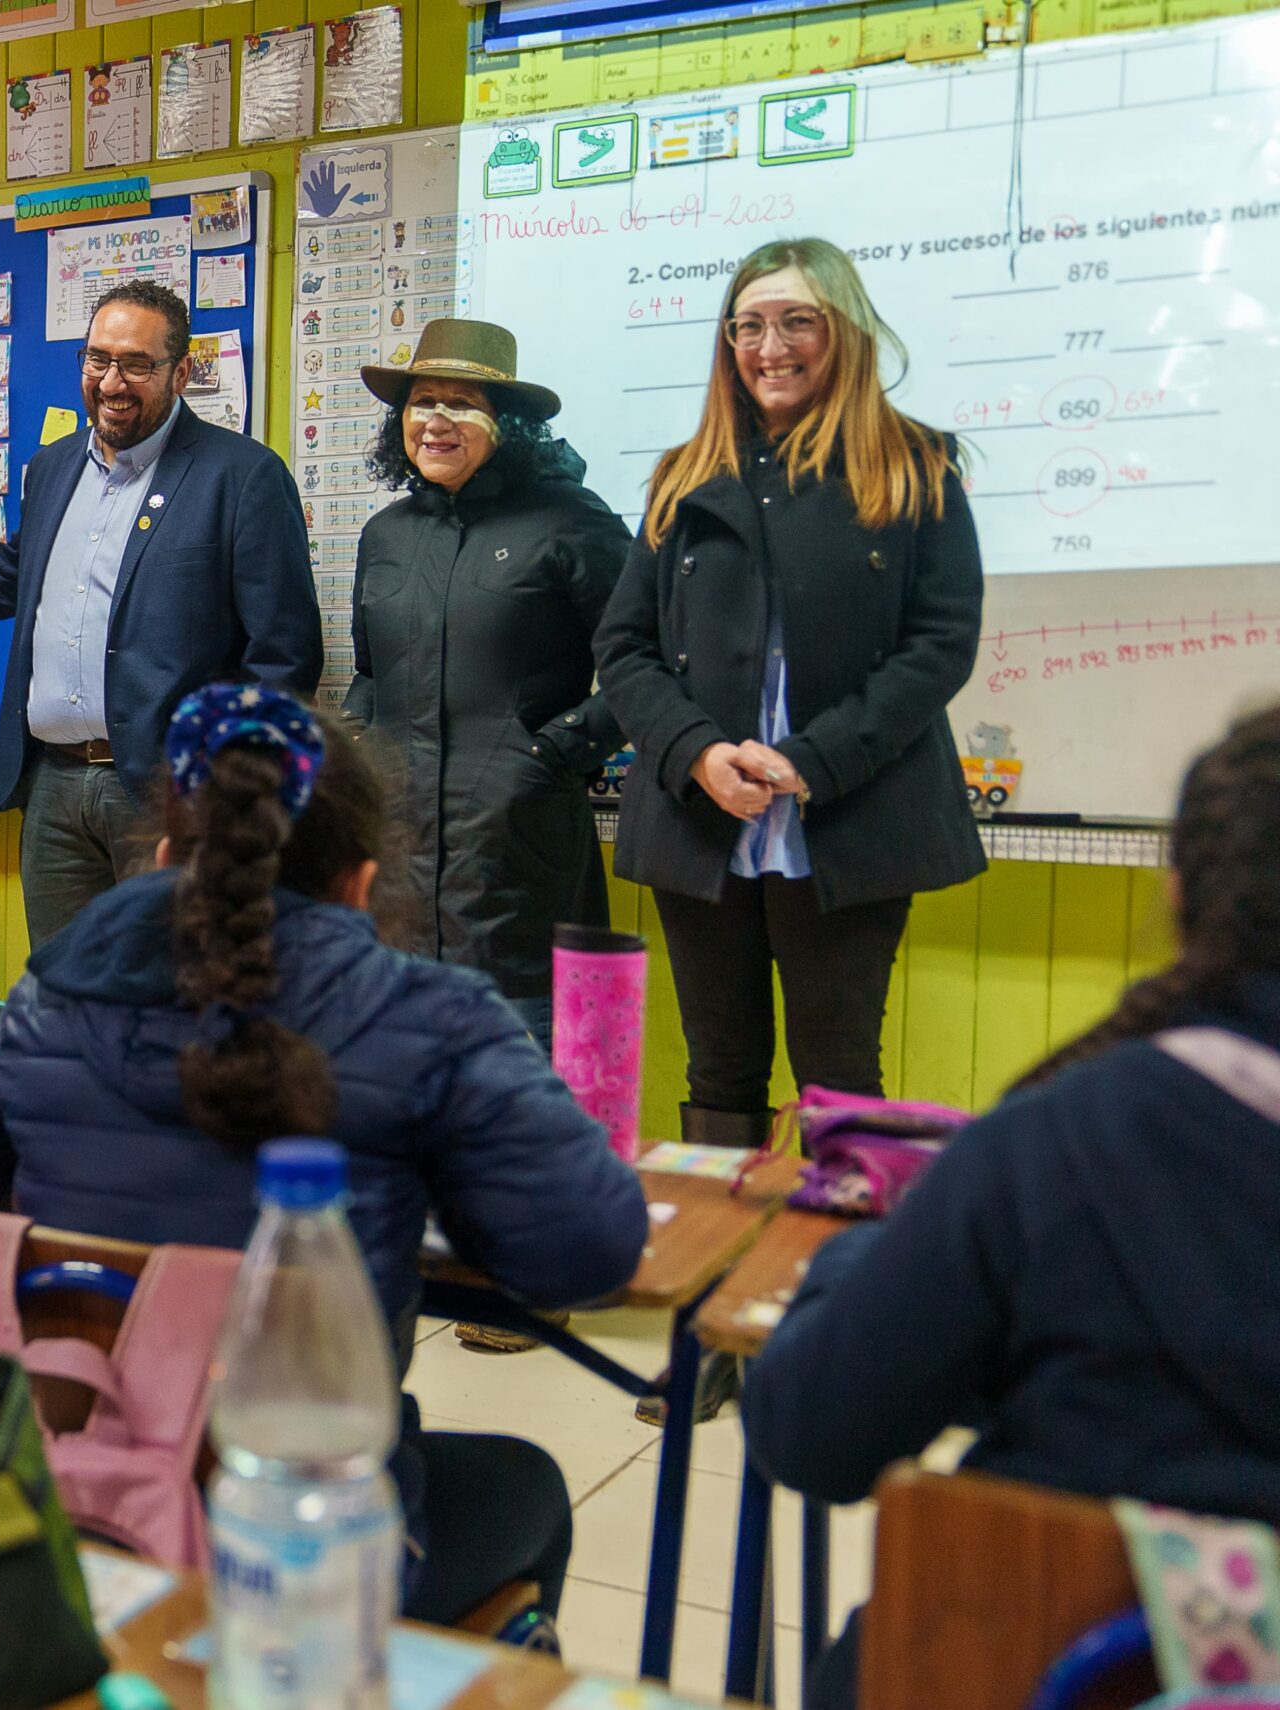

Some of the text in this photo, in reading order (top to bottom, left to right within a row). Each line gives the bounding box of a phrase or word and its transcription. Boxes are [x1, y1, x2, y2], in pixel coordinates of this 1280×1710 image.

[606, 68, 627, 78] Arial
[15, 176, 151, 221] Diario mural
[105, 229, 161, 249] HORARIO
[333, 228, 342, 240] A
[627, 267, 654, 285] 2.-
[899, 243, 913, 261] y
[919, 232, 1010, 256] sucesor
[1019, 224, 1047, 244] de
[1053, 220, 1088, 241] los
[1096, 206, 1222, 239] siguientes
[112, 244, 187, 265] de CLASES
[421, 258, 431, 270] O
[334, 267, 341, 279] B
[1067, 261, 1110, 283] 876
[420, 297, 428, 309] P
[332, 307, 341, 319] C
[1063, 330, 1106, 351] 777
[334, 347, 342, 358] D
[333, 384, 340, 396] E
[1059, 399, 1100, 420] 650
[332, 422, 339, 433] F
[330, 462, 339, 473] G
[1054, 467, 1096, 487] 899
[330, 500, 338, 512] H
[327, 614, 335, 625] K
[328, 652, 335, 663] L
[327, 690, 338, 701] M
